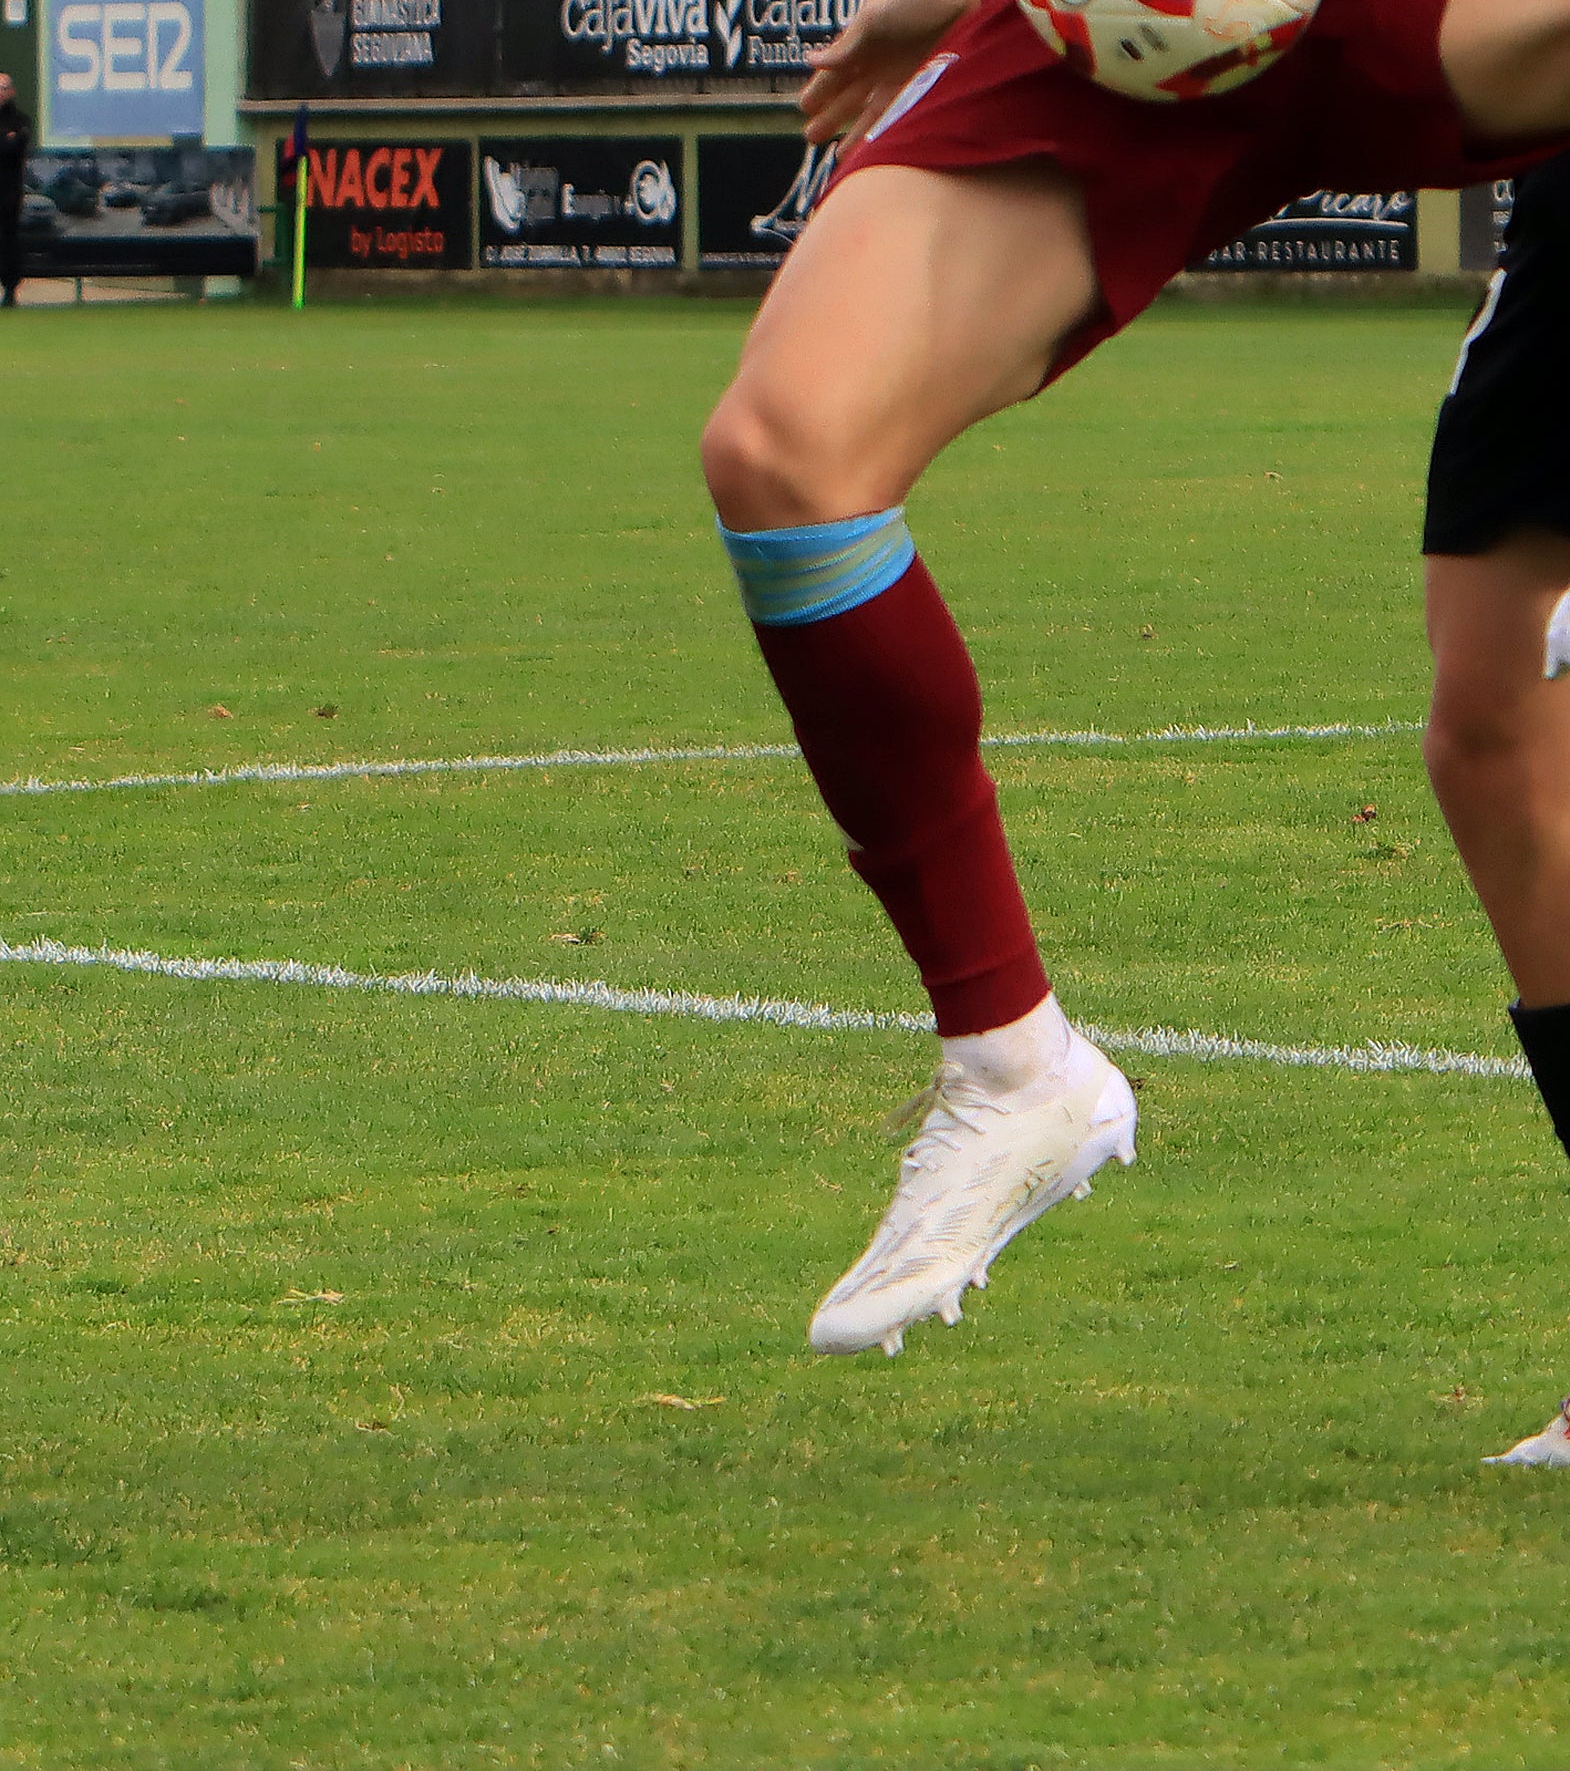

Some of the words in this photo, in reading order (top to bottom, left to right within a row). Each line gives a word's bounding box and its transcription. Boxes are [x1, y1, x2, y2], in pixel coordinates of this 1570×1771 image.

[58, 1, 193, 91] SER
[625, 36, 710, 75] Segovia
[306, 147, 444, 208] NACEX
[350, 225, 373, 258] by
